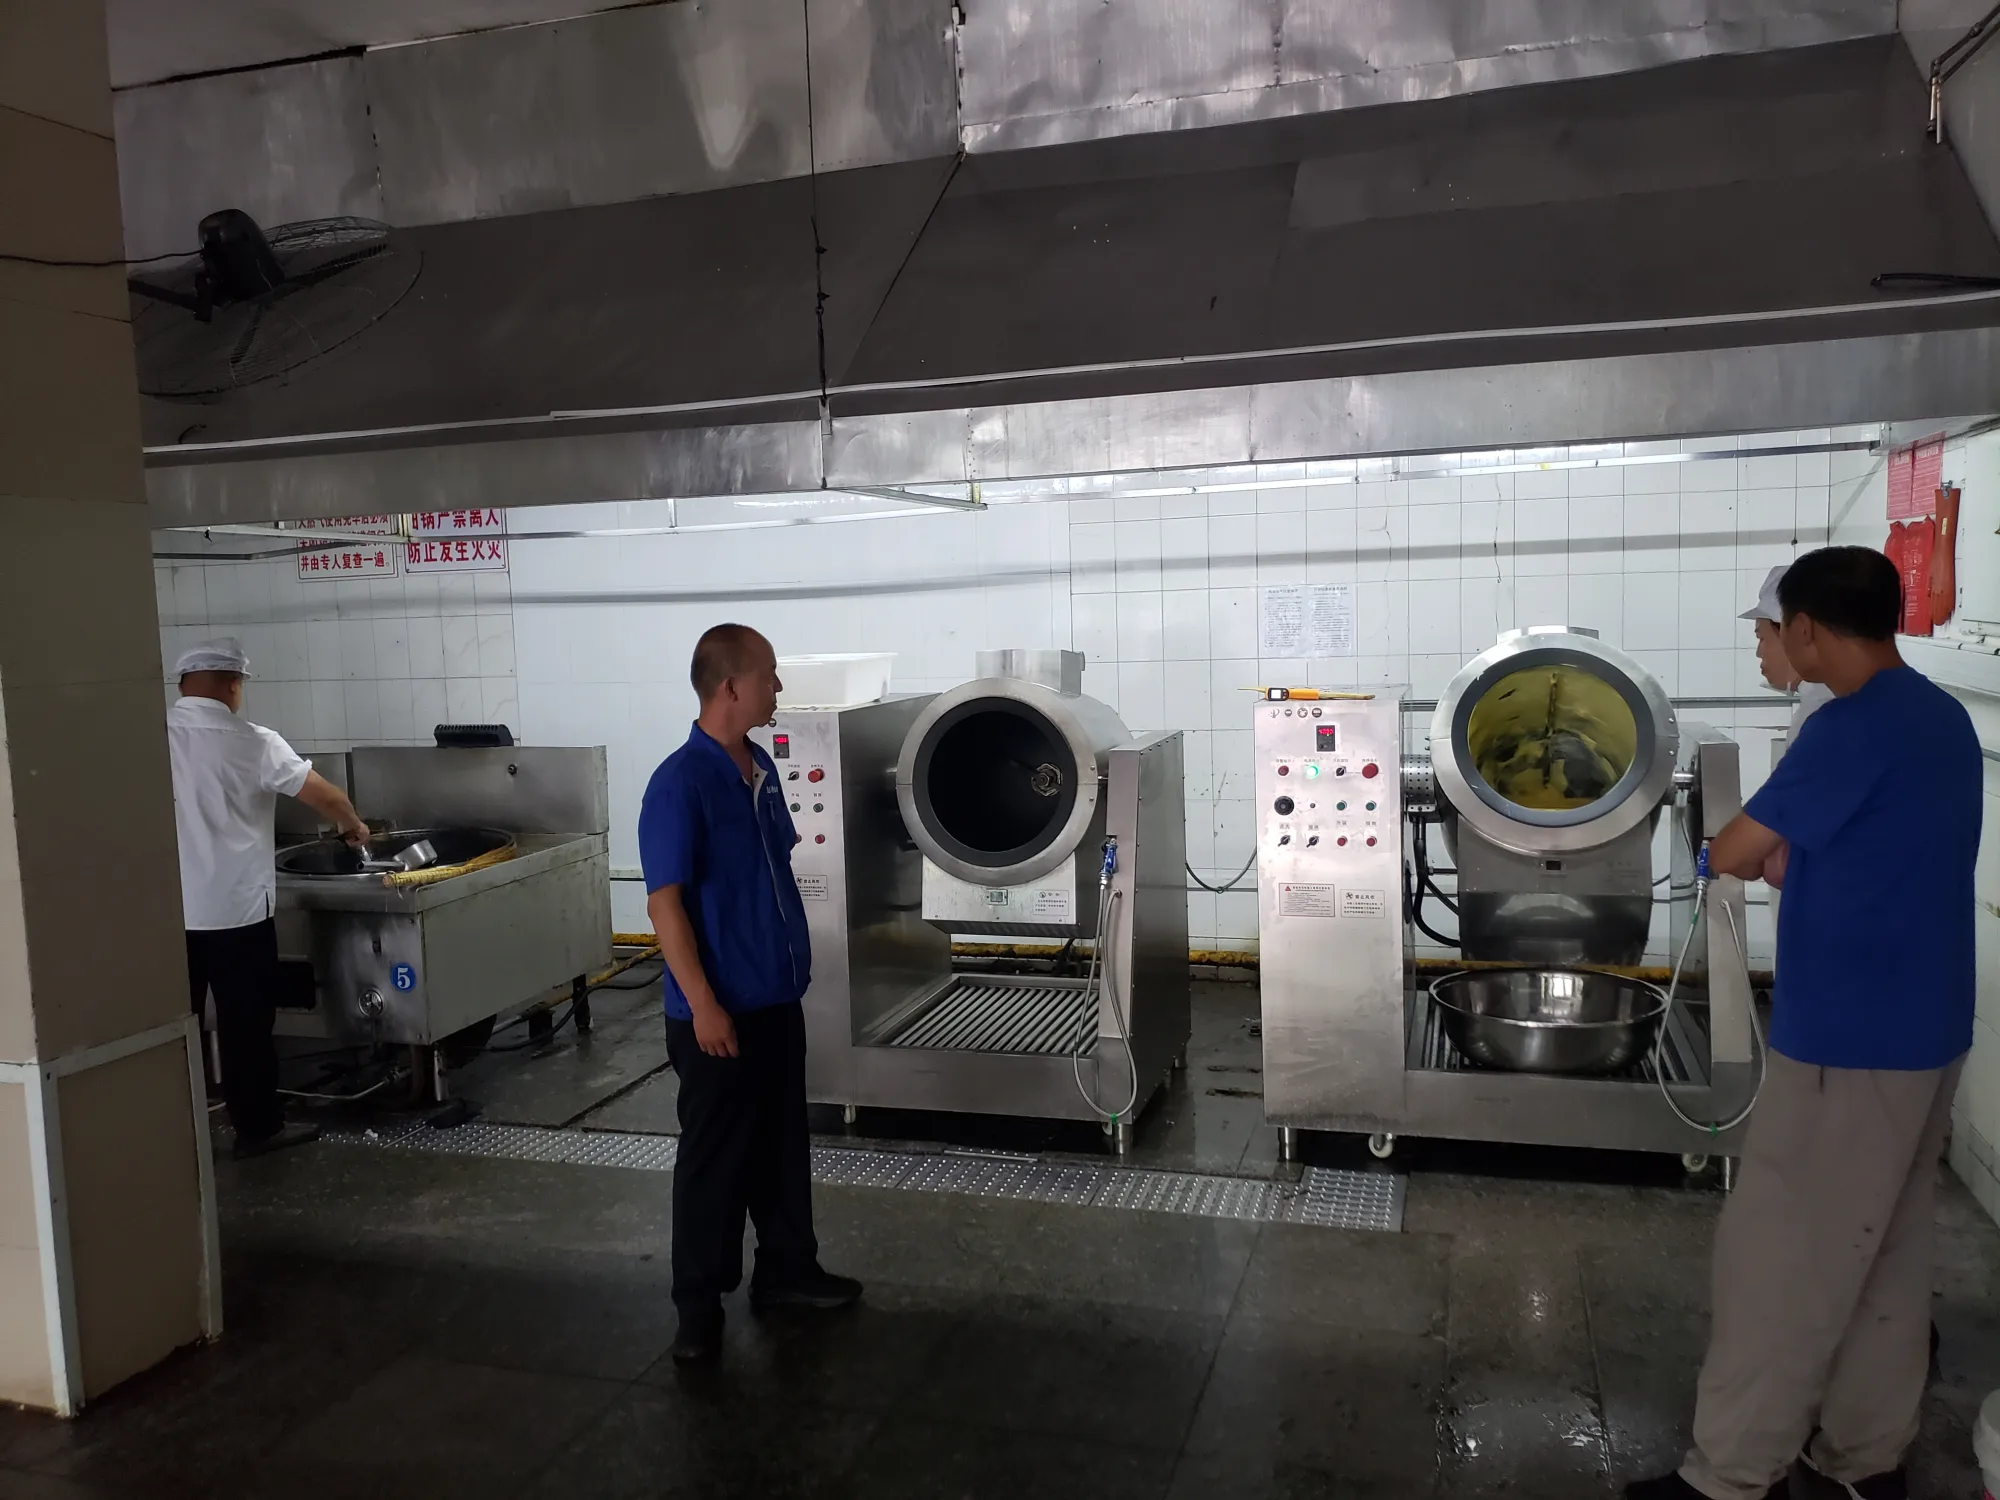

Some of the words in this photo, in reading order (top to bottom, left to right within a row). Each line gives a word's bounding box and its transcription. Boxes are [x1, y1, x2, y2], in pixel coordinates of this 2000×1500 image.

[407, 540, 501, 564] 防止发生火灾
[397, 967, 411, 989] 5
